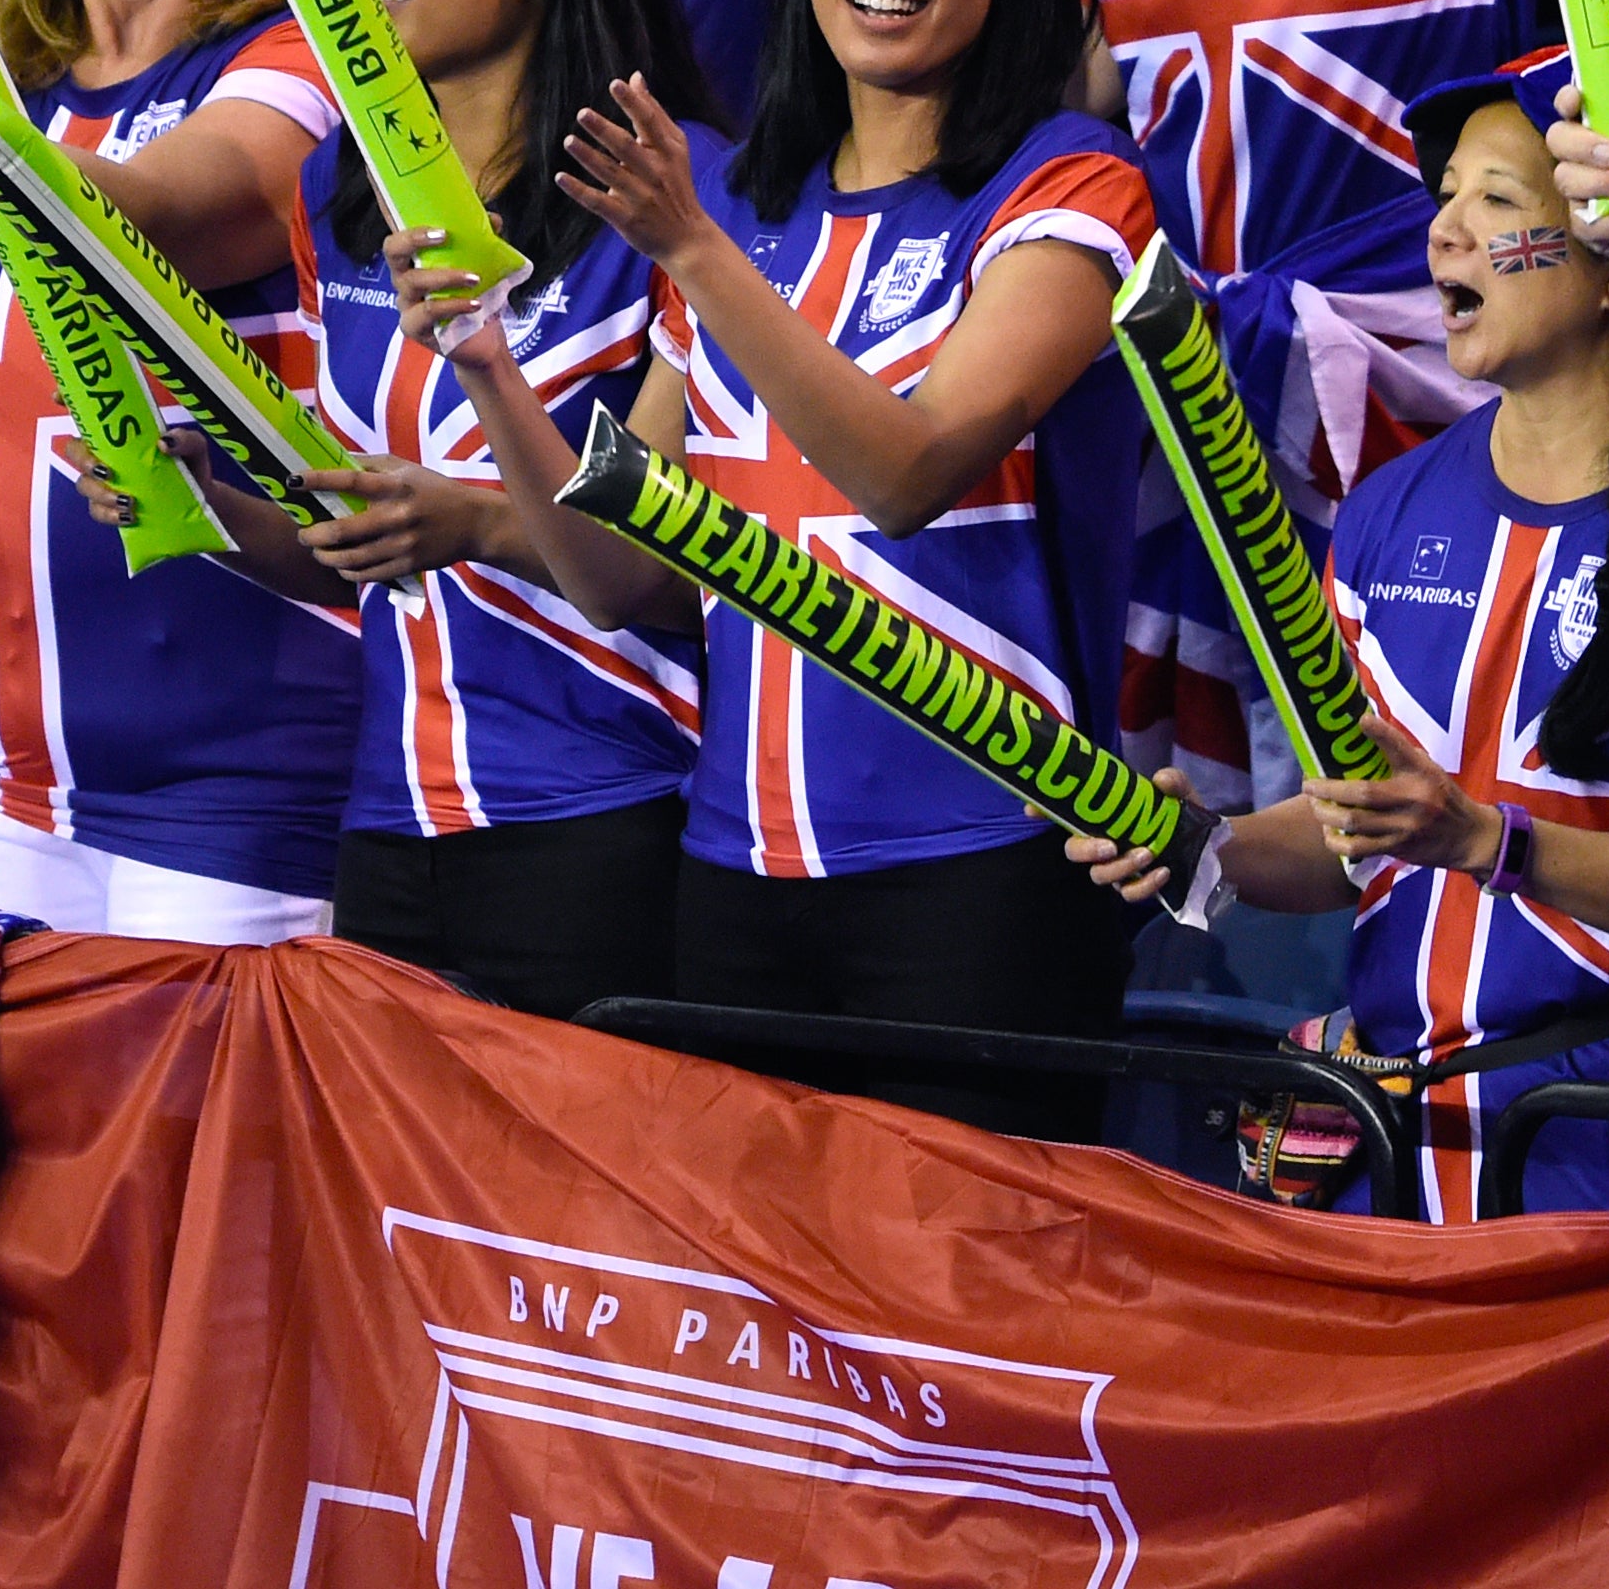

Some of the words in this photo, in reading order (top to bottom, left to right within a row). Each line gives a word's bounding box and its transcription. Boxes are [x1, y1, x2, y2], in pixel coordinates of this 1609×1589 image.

[326, 281, 352, 301] BNP
[349, 285, 398, 310] PARIBA
[24, 247, 142, 450] ARIBAS
[1401, 585, 1477, 609] PARIBAS
[1569, 600, 1598, 627] TEN
[627, 447, 1182, 859] WEARETENNIS.COM
[1204, 1109, 1225, 1126] 36
[508, 1274, 619, 1340] BNP
[671, 1307, 948, 1430] PARIBAS
